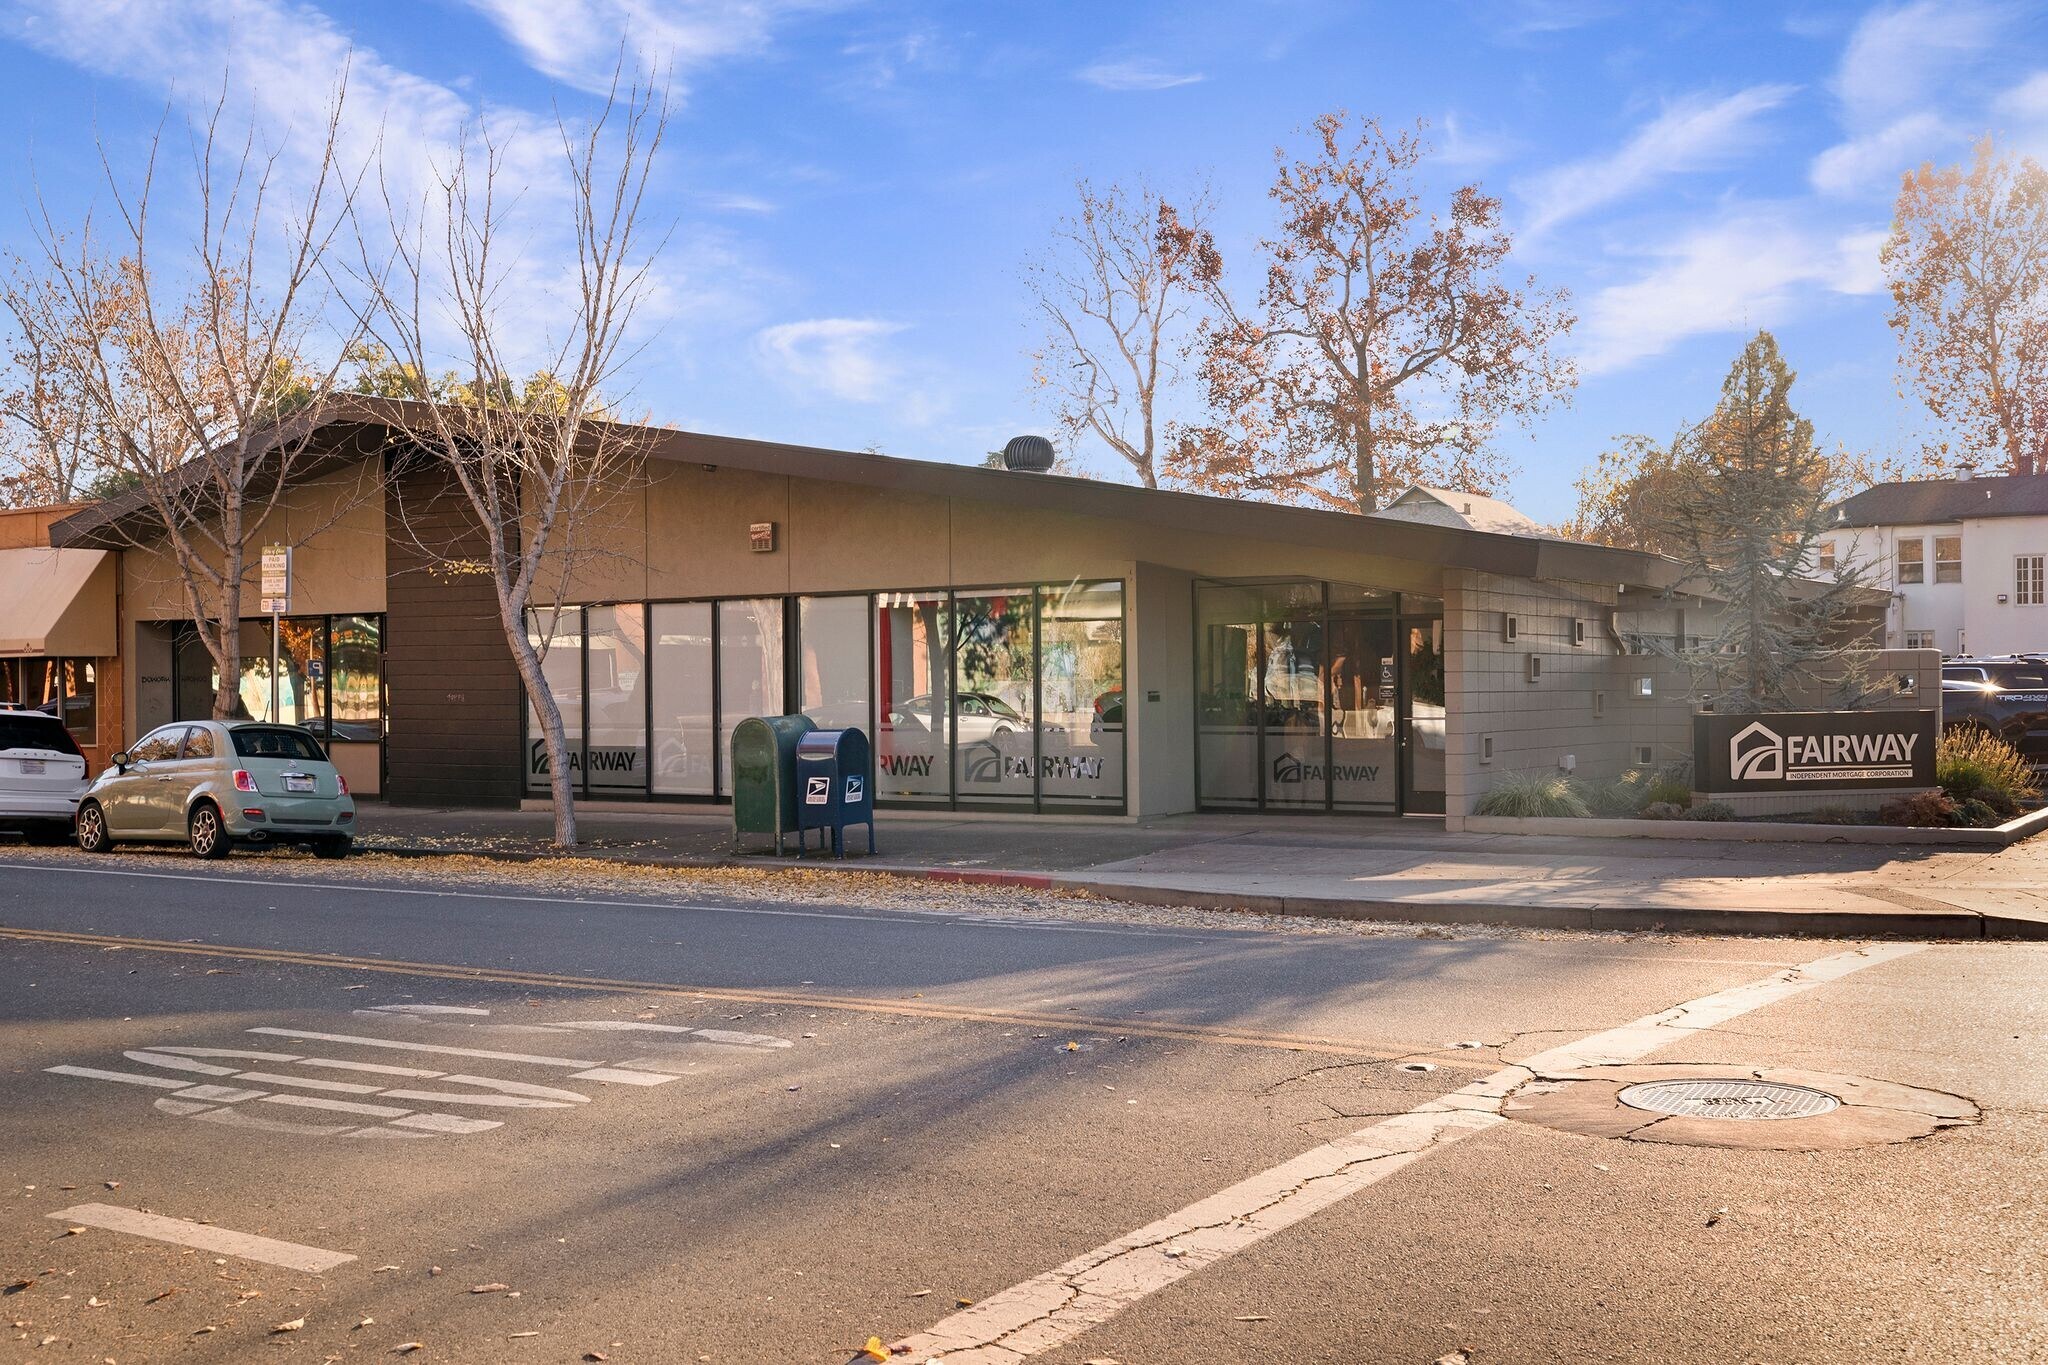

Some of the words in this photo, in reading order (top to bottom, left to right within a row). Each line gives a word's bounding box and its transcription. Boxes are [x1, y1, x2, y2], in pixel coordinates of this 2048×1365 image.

[1787, 733, 1919, 764] FAIRWAY
[1004, 755, 1105, 779] FAIRWAY
[1303, 765, 1380, 781] FAIRWAY
[1790, 771, 1831, 779] INDEPENDENT
[1832, 771, 1866, 779] MORTGAGE
[1866, 770, 1909, 778] CORPORATION
